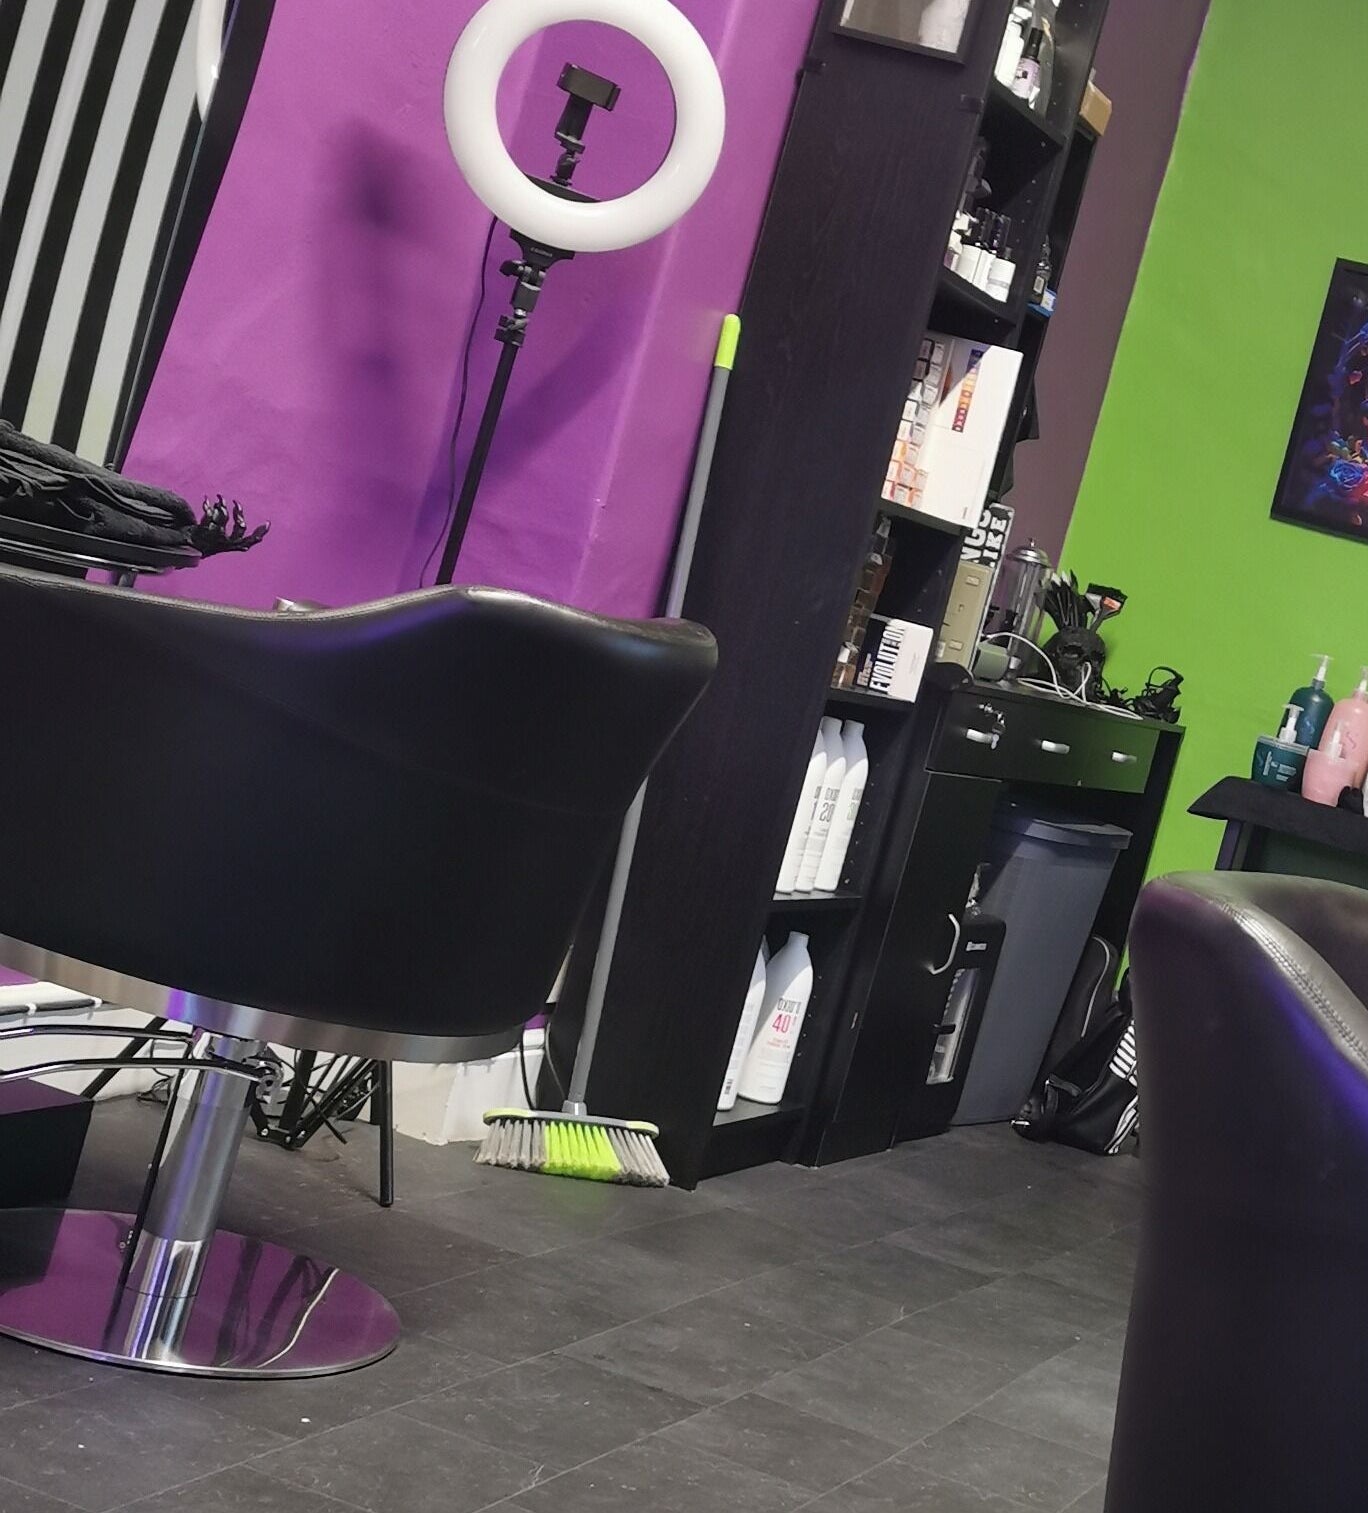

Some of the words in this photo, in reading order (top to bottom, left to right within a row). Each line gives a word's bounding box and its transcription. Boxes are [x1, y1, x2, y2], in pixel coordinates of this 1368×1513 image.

[869, 625, 905, 693] EVOLUTION
[819, 802, 836, 823] 20
[772, 1013, 792, 1034] 40
